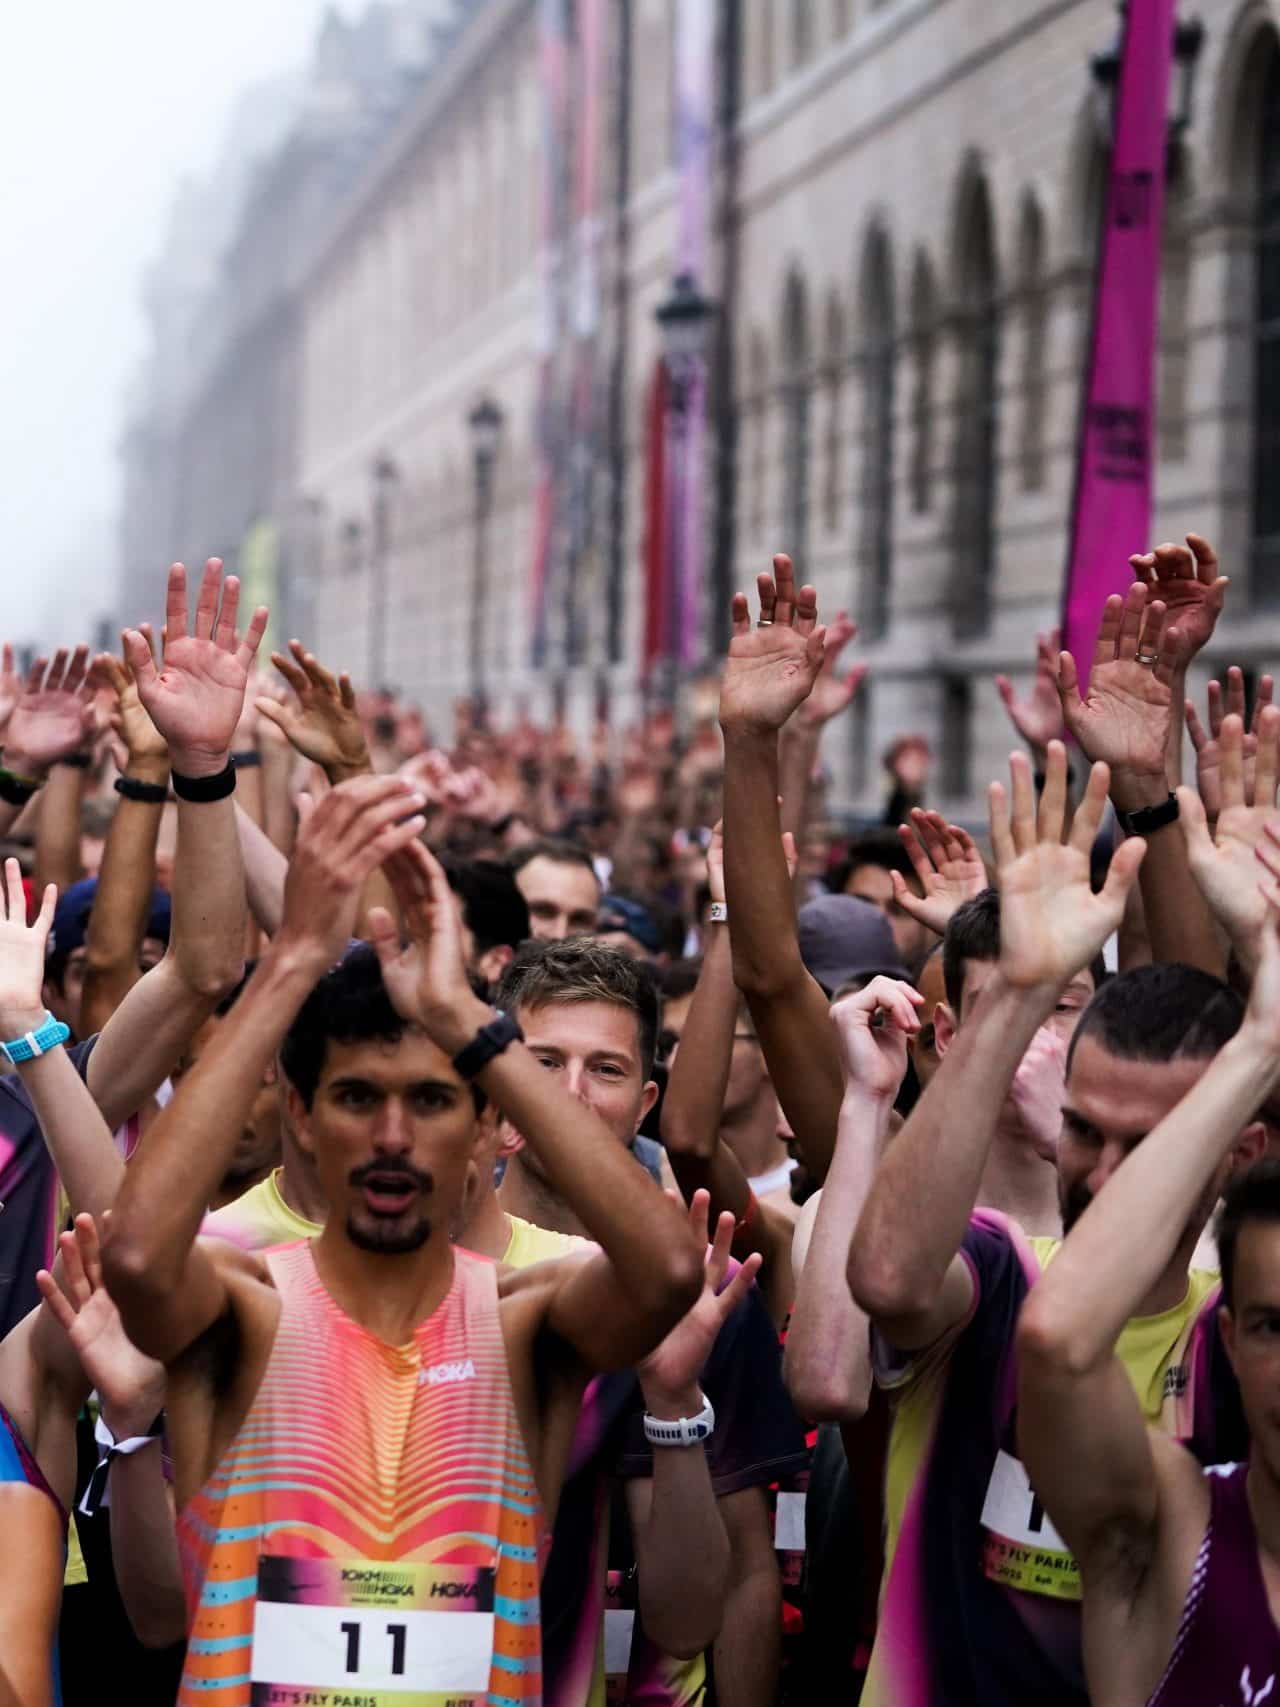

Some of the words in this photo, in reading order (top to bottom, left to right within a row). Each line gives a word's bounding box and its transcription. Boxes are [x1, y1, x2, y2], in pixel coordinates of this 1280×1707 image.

[1035, 1554, 1080, 1571] PARIS
[341, 1622, 407, 1675] 11
[304, 1693, 329, 1706] FLY
[333, 1695, 377, 1707] PARIS
